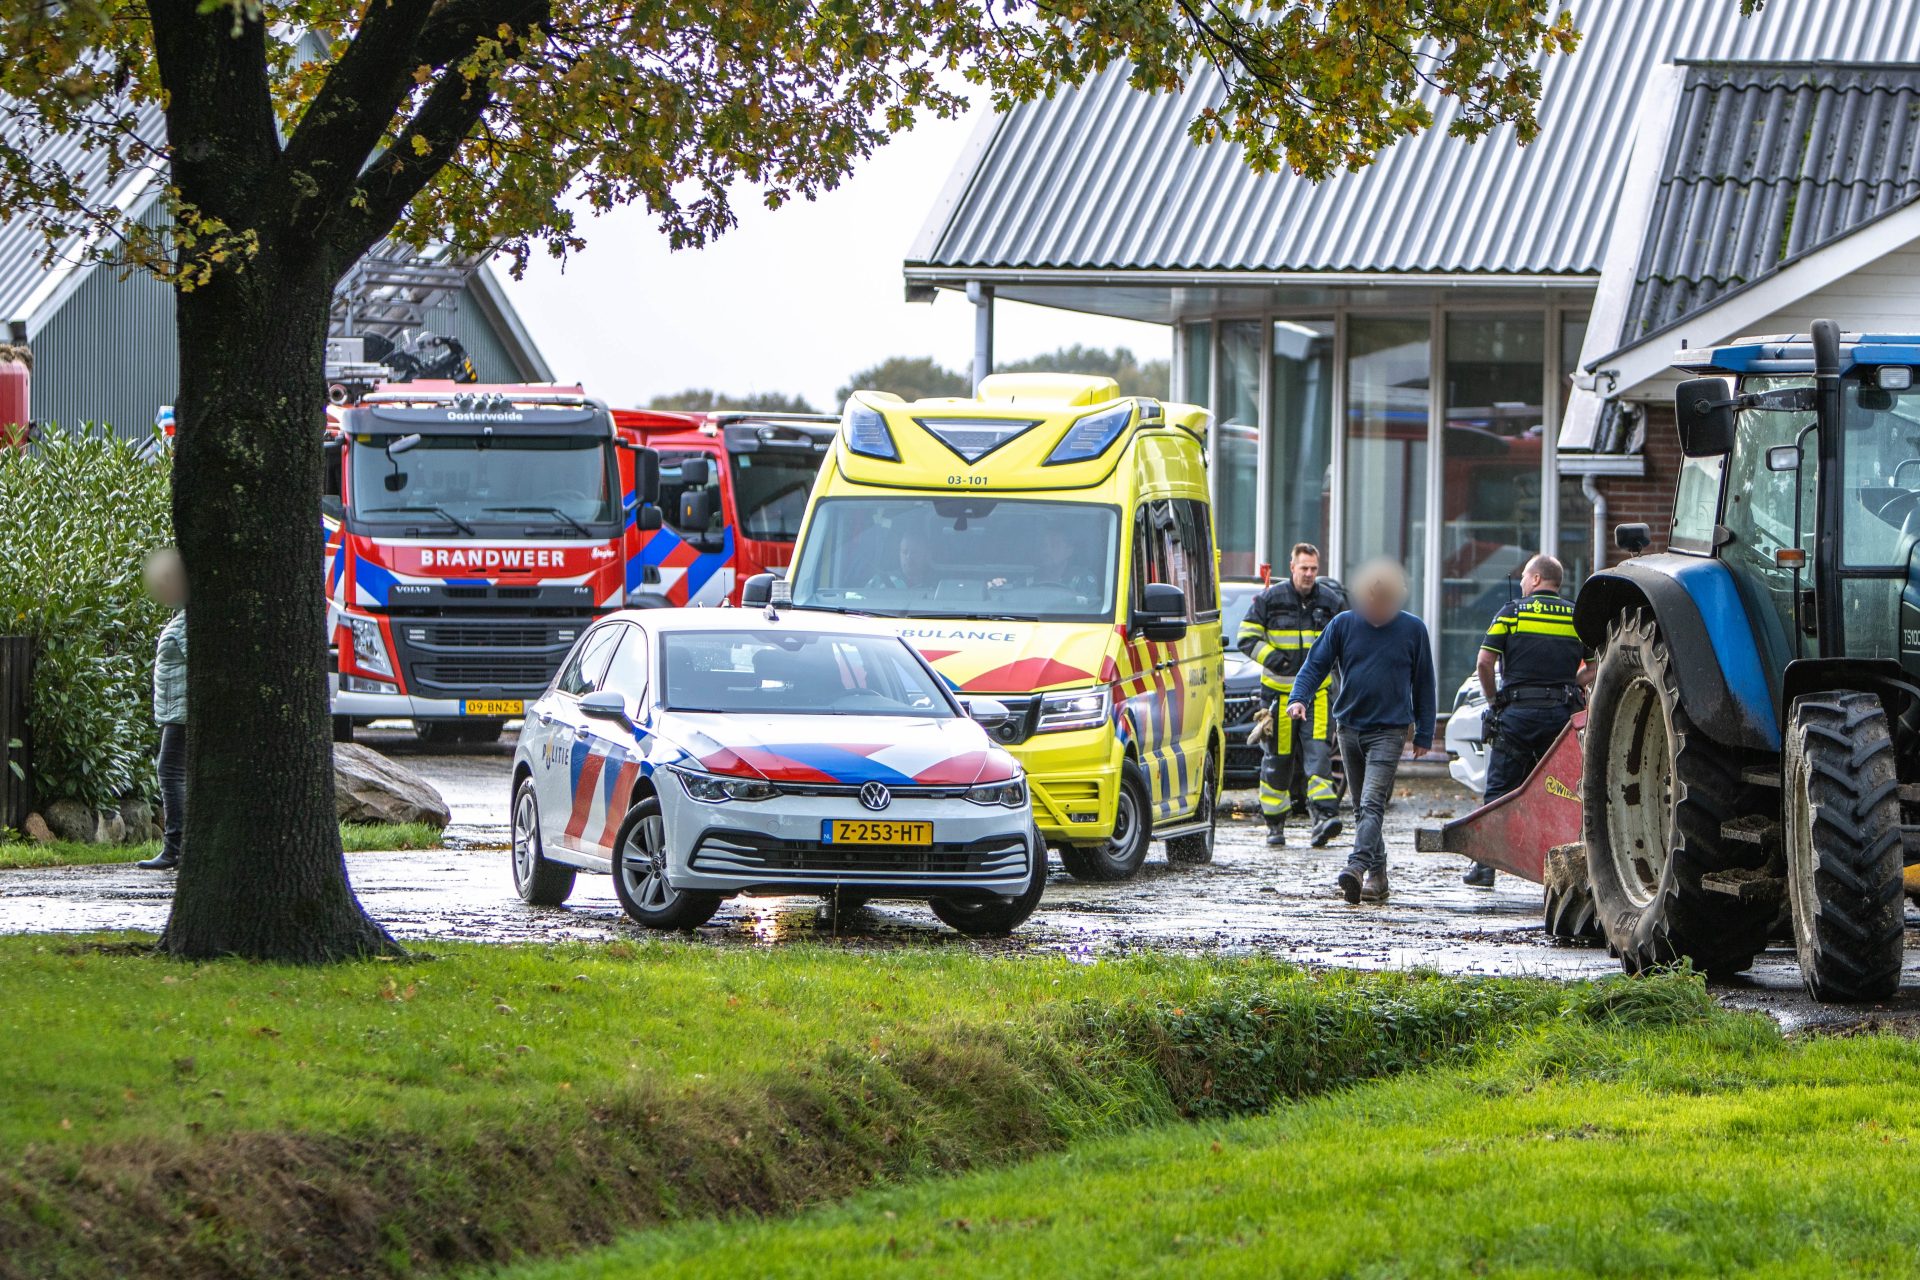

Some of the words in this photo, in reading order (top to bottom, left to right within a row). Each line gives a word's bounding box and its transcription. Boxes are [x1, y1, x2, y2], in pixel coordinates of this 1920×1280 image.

[447, 411, 523, 421] Oosterwolde
[947, 475, 988, 485] 03-101
[420, 548, 565, 568] BRANDWEER
[395, 585, 430, 594] VOLVO
[1526, 601, 1572, 614] POLITIE
[895, 629, 1017, 642] BULANCE
[542, 742, 569, 770] POLITIE
[839, 823, 925, 841] Z-253-HT
